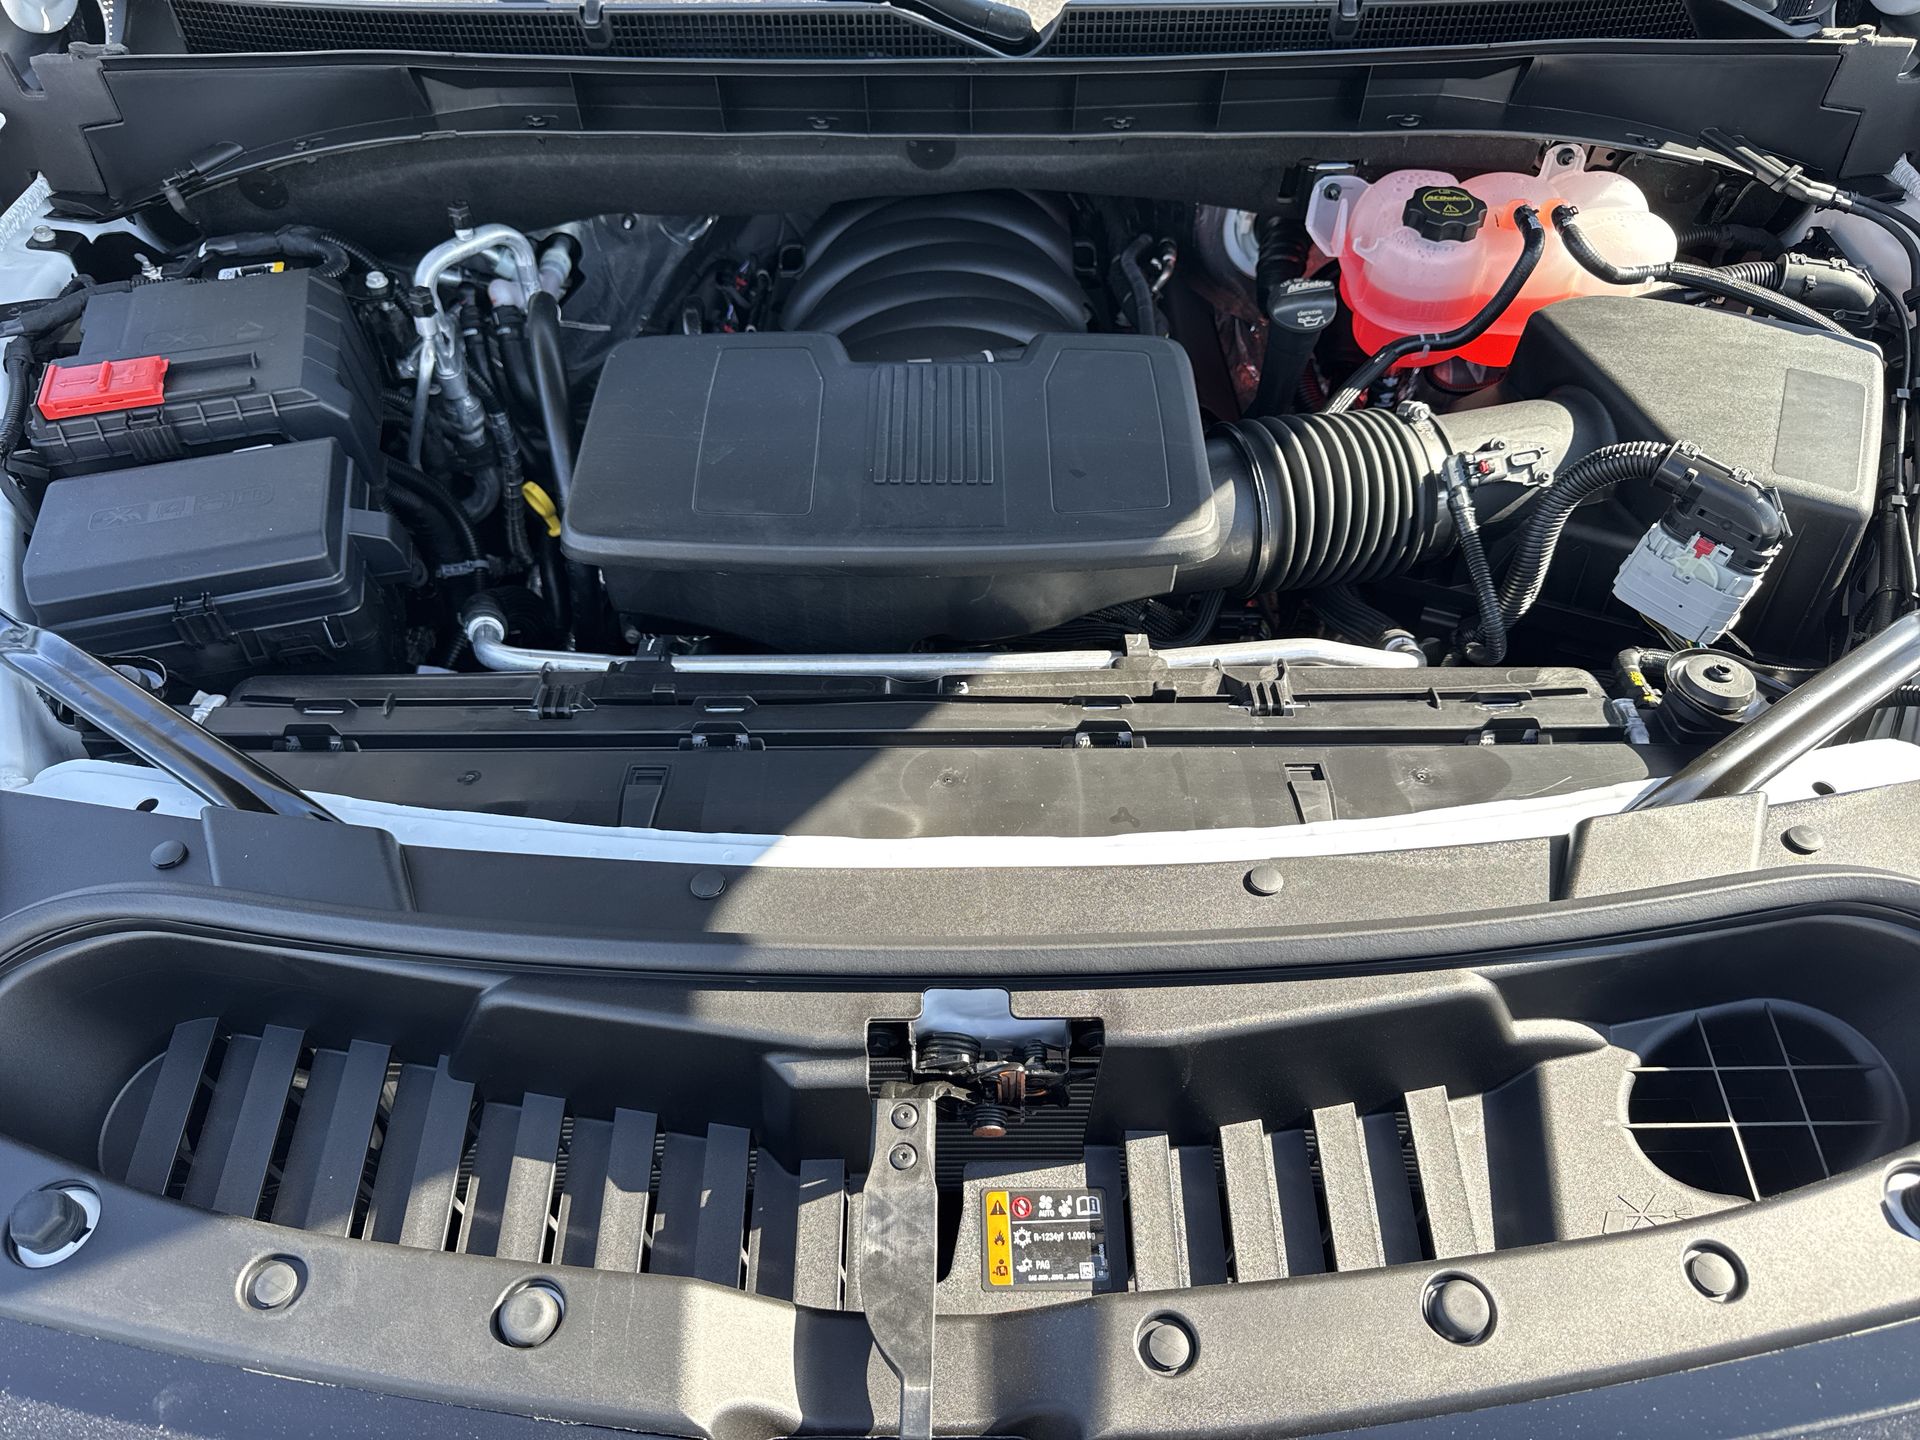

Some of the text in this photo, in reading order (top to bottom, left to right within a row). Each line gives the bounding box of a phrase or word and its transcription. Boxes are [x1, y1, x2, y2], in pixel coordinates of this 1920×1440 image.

[1287, 280, 1332, 294] ACDelco
[1039, 1209, 1055, 1217] AUTO
[1034, 1231, 1096, 1242] R-1234yf 1.000 kg
[1036, 1260, 1051, 1270] PAG
